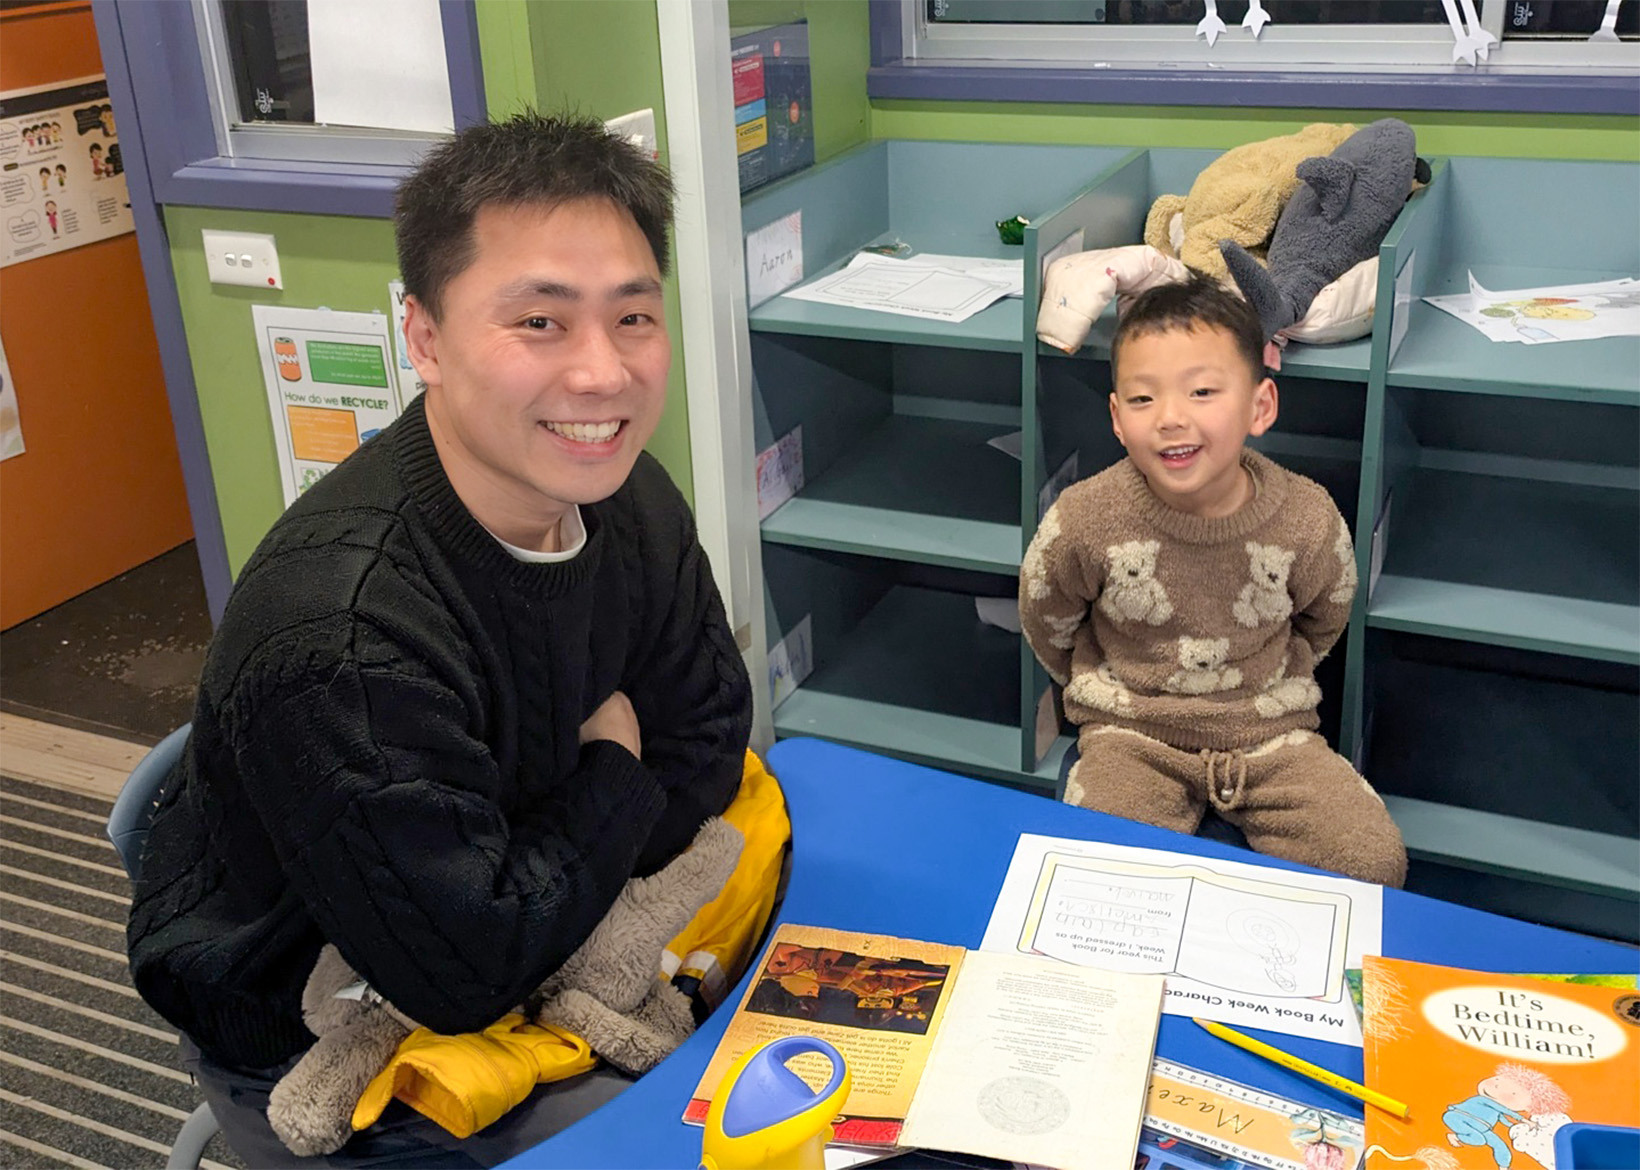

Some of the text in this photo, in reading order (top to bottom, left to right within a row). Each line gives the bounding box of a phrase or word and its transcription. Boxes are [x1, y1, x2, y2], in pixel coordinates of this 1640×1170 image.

[284, 392, 389, 410] How do we RECYCLE?
[1147, 909, 1172, 918] from
[1085, 937, 1126, 948] dressed
[1136, 944, 1166, 954] Week,
[1072, 944, 1164, 963] This year for Book
[1163, 989, 1344, 1028] My Book Week Charac
[1497, 990, 1543, 1012] It's
[1452, 1002, 1595, 1040] Bedtime,
[1456, 1024, 1595, 1059] William!
